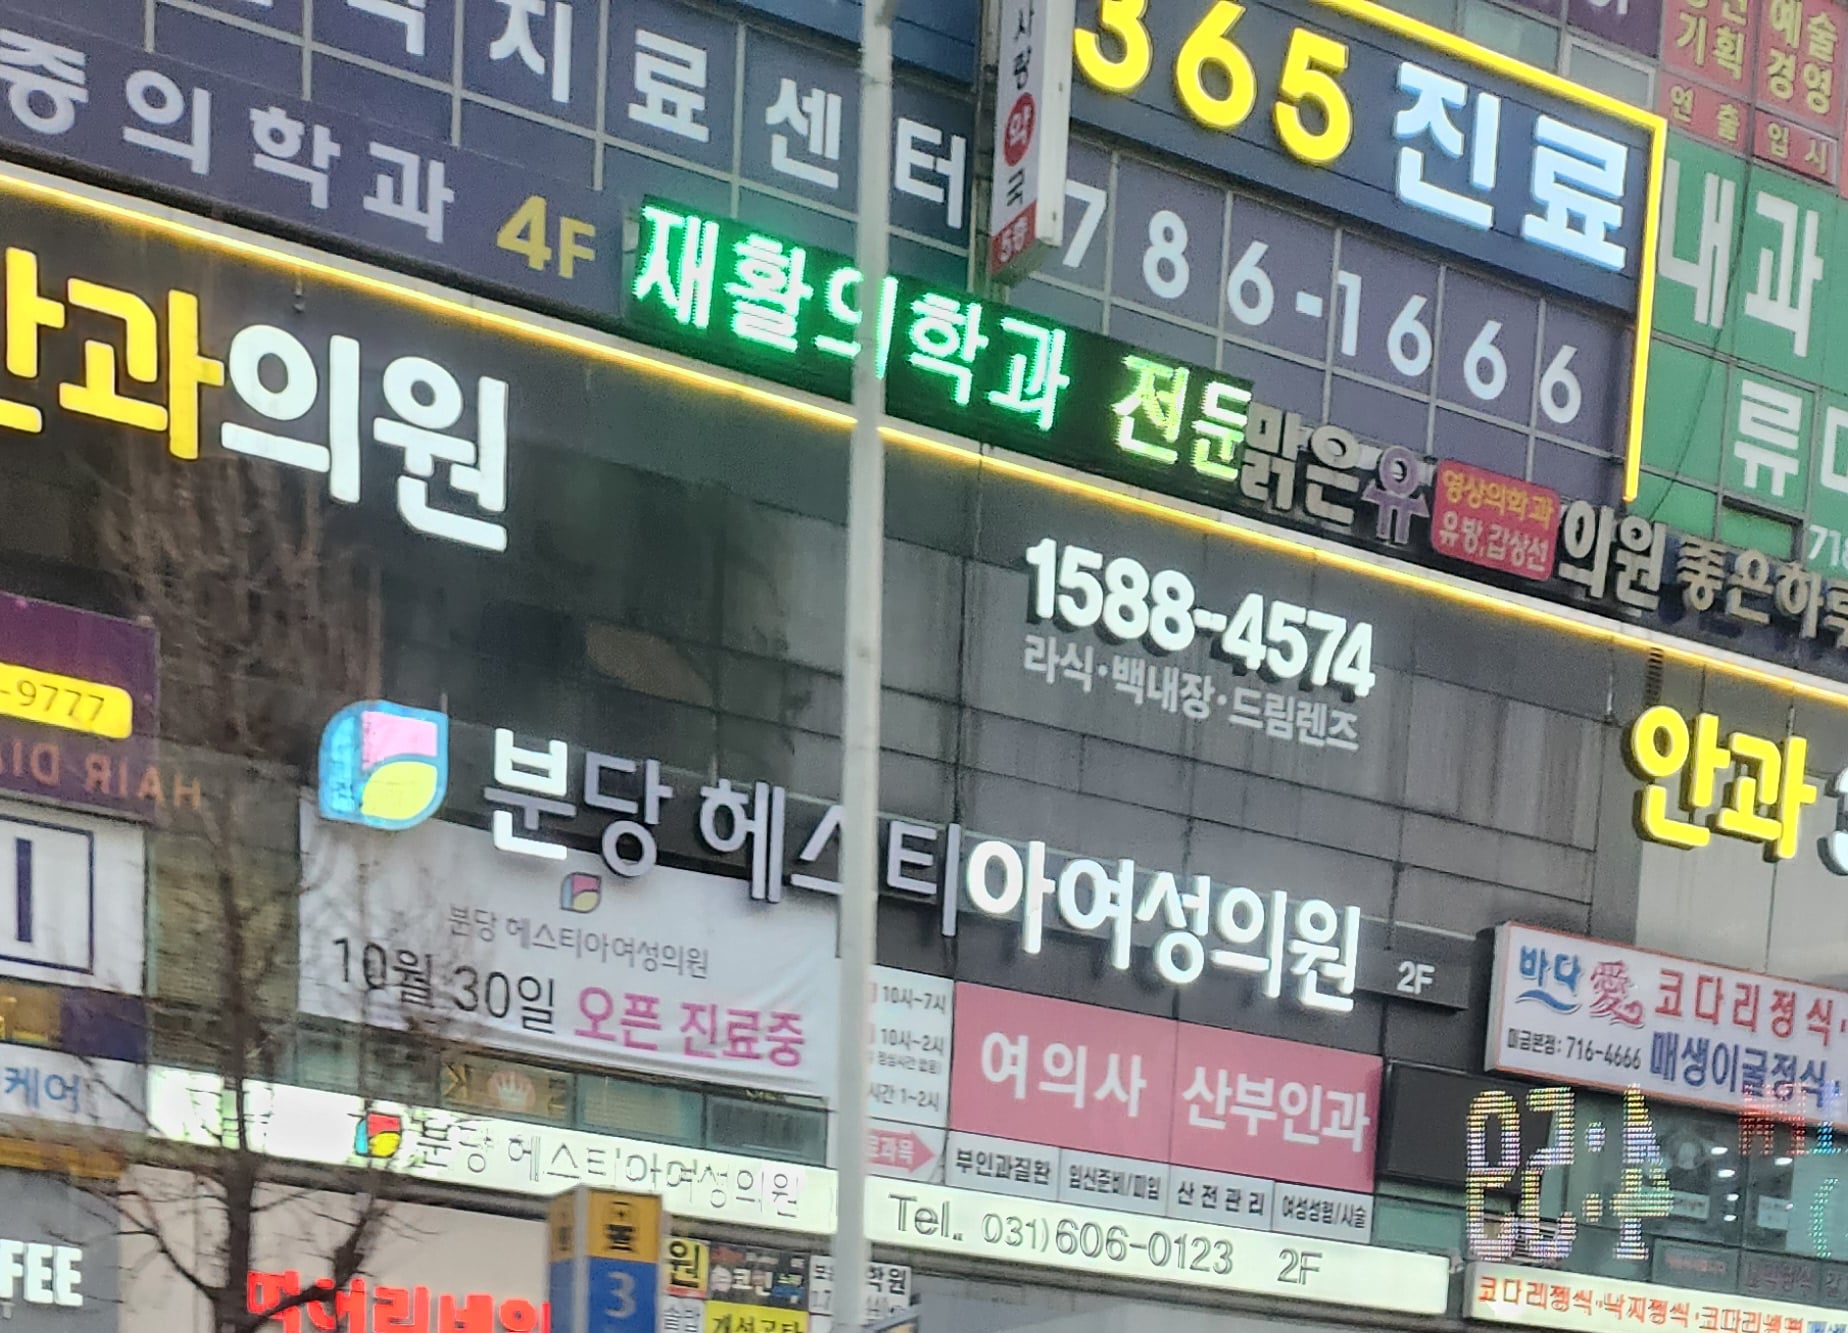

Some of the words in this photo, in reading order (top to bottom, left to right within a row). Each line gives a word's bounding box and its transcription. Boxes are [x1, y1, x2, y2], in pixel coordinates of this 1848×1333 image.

[1676, 12, 1745, 80] 기획
[1767, 48, 1833, 114] 경영
[1073, 0, 1353, 162] 365
[1395, 62, 1629, 270] 진료
[498, 196, 595, 279] 4F
[632, 203, 1070, 431] 재활의학과
[1442, 470, 1555, 530] 영상의학과
[1558, 500, 1667, 611] 의원
[1025, 538, 1376, 697] 1588-4574
[484, 726, 674, 878] 분당
[699, 777, 1361, 1014] 헤스티아여성의원
[1396, 962, 1437, 996] 2F
[447, 904, 498, 943] 분당
[506, 916, 709, 980] 헤스티아여성의원
[1519, 945, 1582, 994] 바다
[332, 936, 436, 1009] 10월
[452, 964, 556, 1035] 30일
[573, 985, 663, 1052] 오픈
[680, 1000, 806, 1068] 진료중
[4, 1065, 80, 1114] 케어
[981, 1031, 1148, 1119] 여의사
[1182, 1066, 1370, 1153] 산부인과
[956, 1148, 1052, 1187] 부인과질환
[0, 1238, 84, 1307] FEE
[604, 1270, 637, 1318] 3
[1277, 1247, 1323, 1287] 2F
